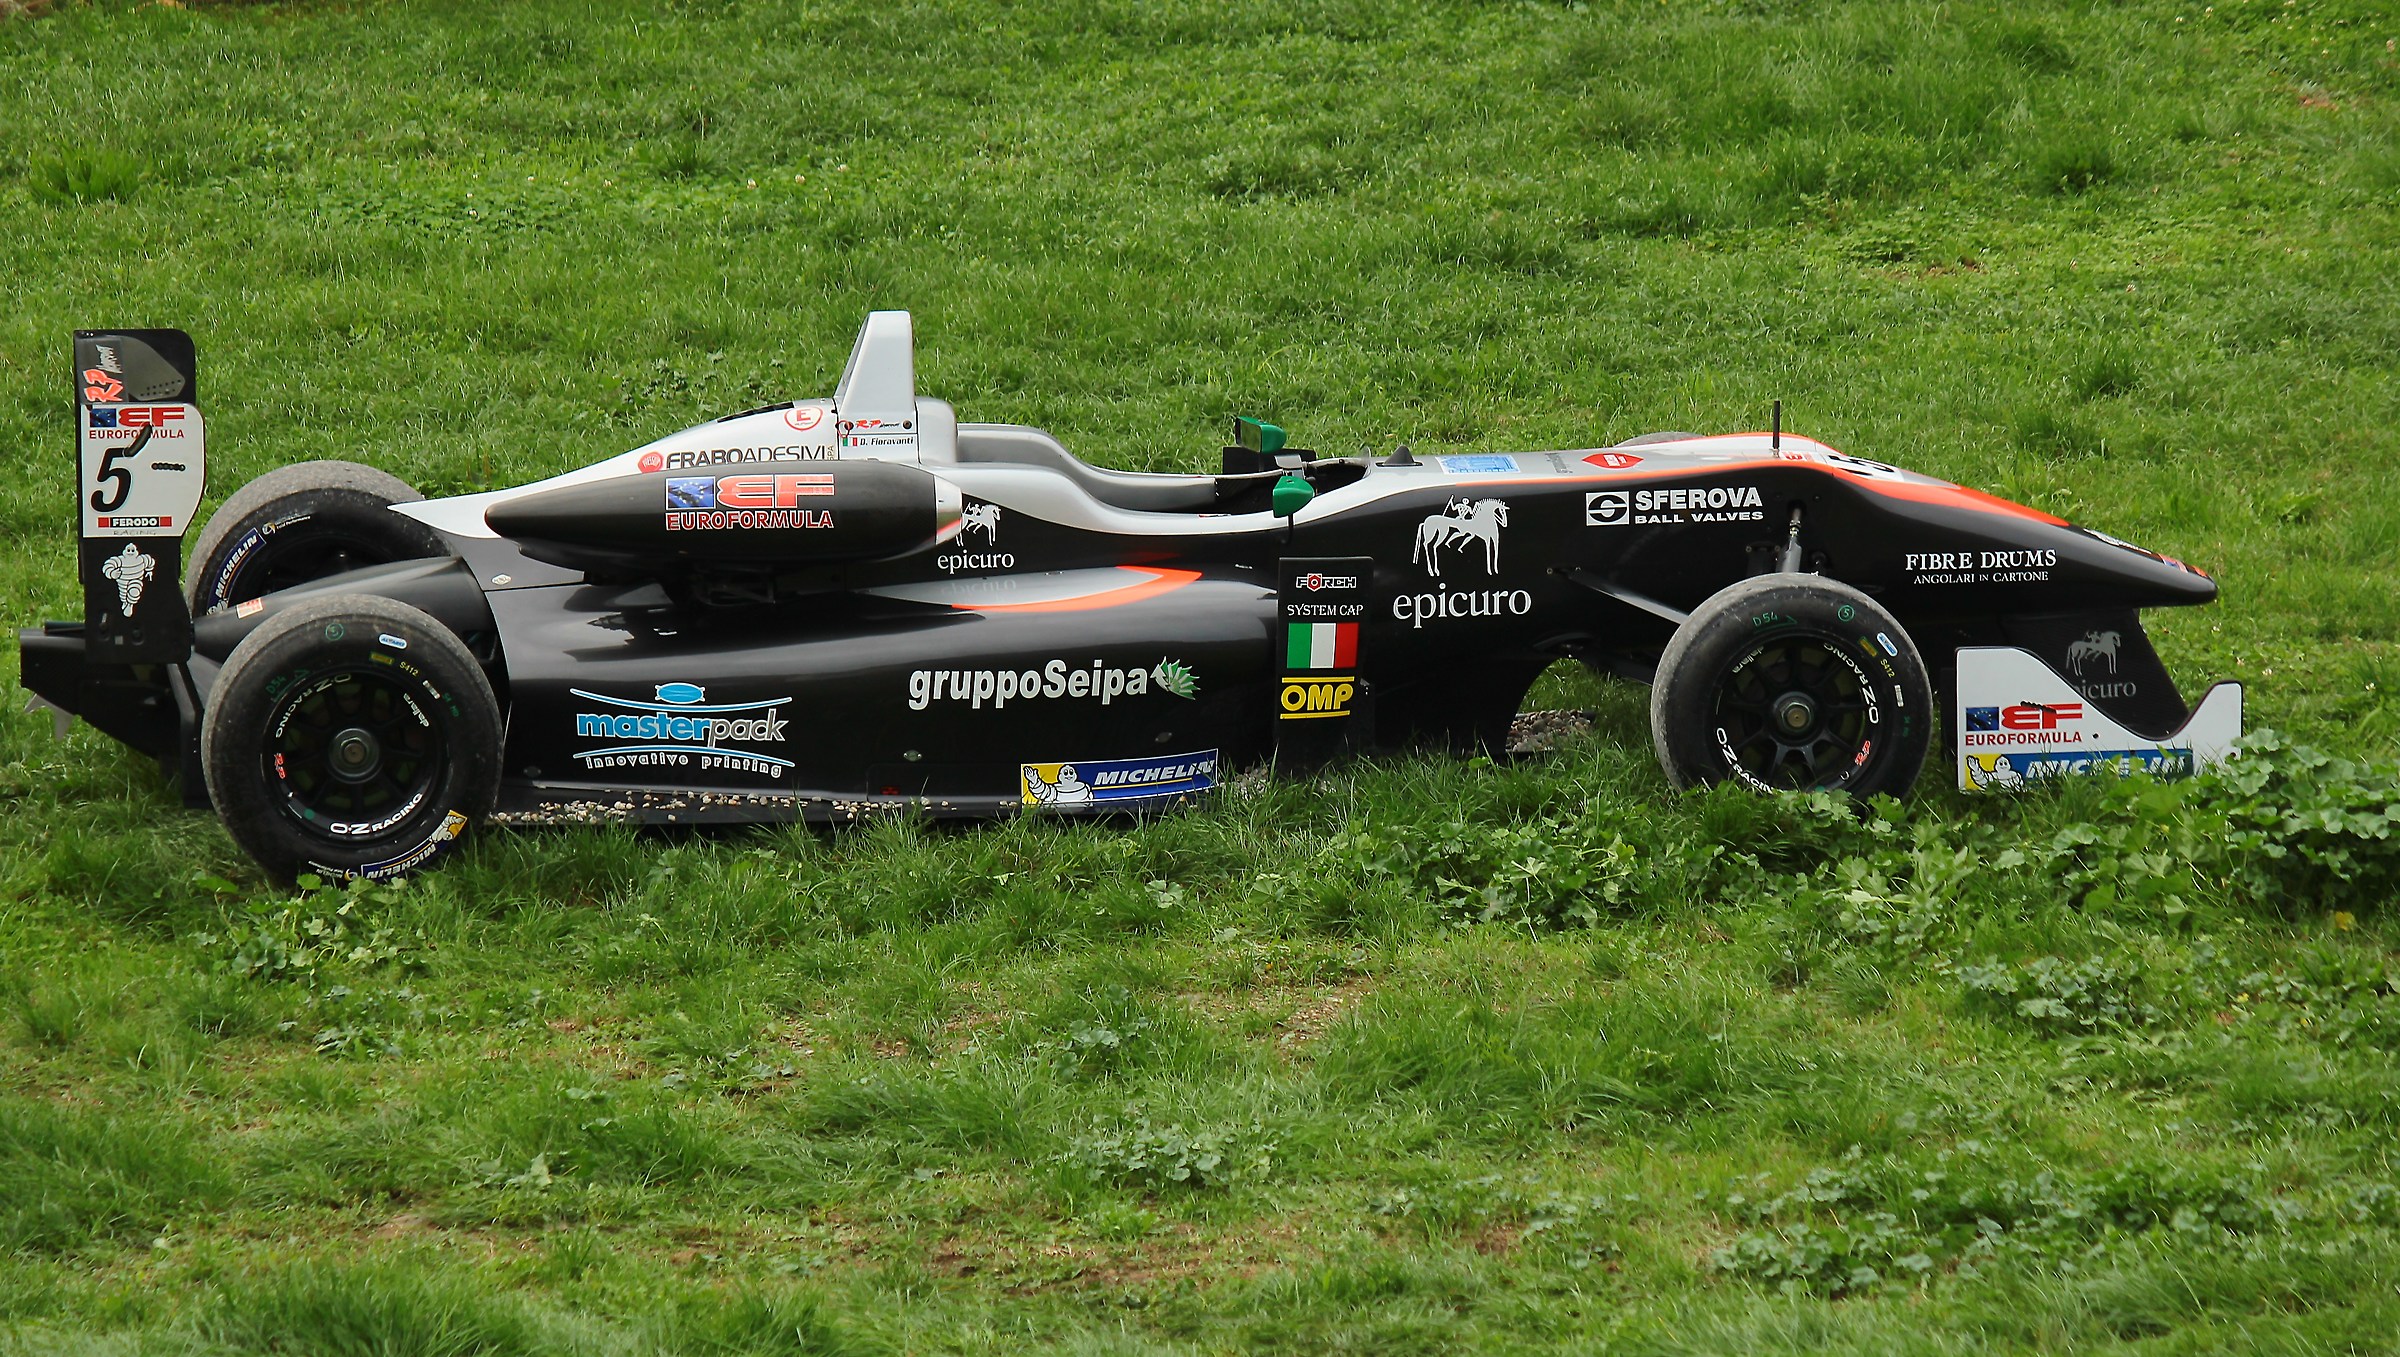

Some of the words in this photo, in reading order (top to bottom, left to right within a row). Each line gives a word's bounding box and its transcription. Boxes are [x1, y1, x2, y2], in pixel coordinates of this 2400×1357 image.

[118, 407, 184, 427] EF
[796, 409, 811, 422] E
[89, 430, 184, 439] EUROFOMULA
[871, 436, 914, 446] Fioravanti
[90, 447, 133, 512] 5
[716, 474, 834, 508] EF
[1634, 486, 1763, 511] SFEROVA
[112, 518, 158, 527] FERODO
[666, 510, 835, 531] EUROFORMULA
[1634, 514, 1684, 524] BALL
[1692, 511, 1764, 522] VALVES
[215, 534, 258, 598] MICHELIN
[937, 549, 1015, 574] epicuro
[1905, 552, 1974, 570] FIBRE
[1980, 549, 2057, 568] DRUMS
[1914, 573, 1975, 584] ANGOLARI
[1980, 574, 1989, 582] IN
[1992, 571, 2049, 582] CARTONE
[1286, 603, 1336, 616] SYSTEM
[1339, 604, 1364, 616] CAP
[1392, 582, 1532, 629] epicuro
[400, 660, 419, 677] S412
[1880, 658, 1896, 678] S412
[908, 659, 1148, 710] gruppoSeipa
[2074, 680, 2137, 700] icuro
[1280, 683, 1354, 712] OMP
[576, 708, 790, 748] masterpack
[2002, 704, 2082, 730] EF
[1965, 732, 2082, 746] EUROFORMULA
[585, 752, 689, 769] innovative
[702, 754, 782, 778] printing
[1094, 760, 1215, 786] MICHELIN
[1733, 764, 1784, 794] RACIN
[372, 793, 423, 832] RACING
[366, 844, 436, 879] MICHELIN
